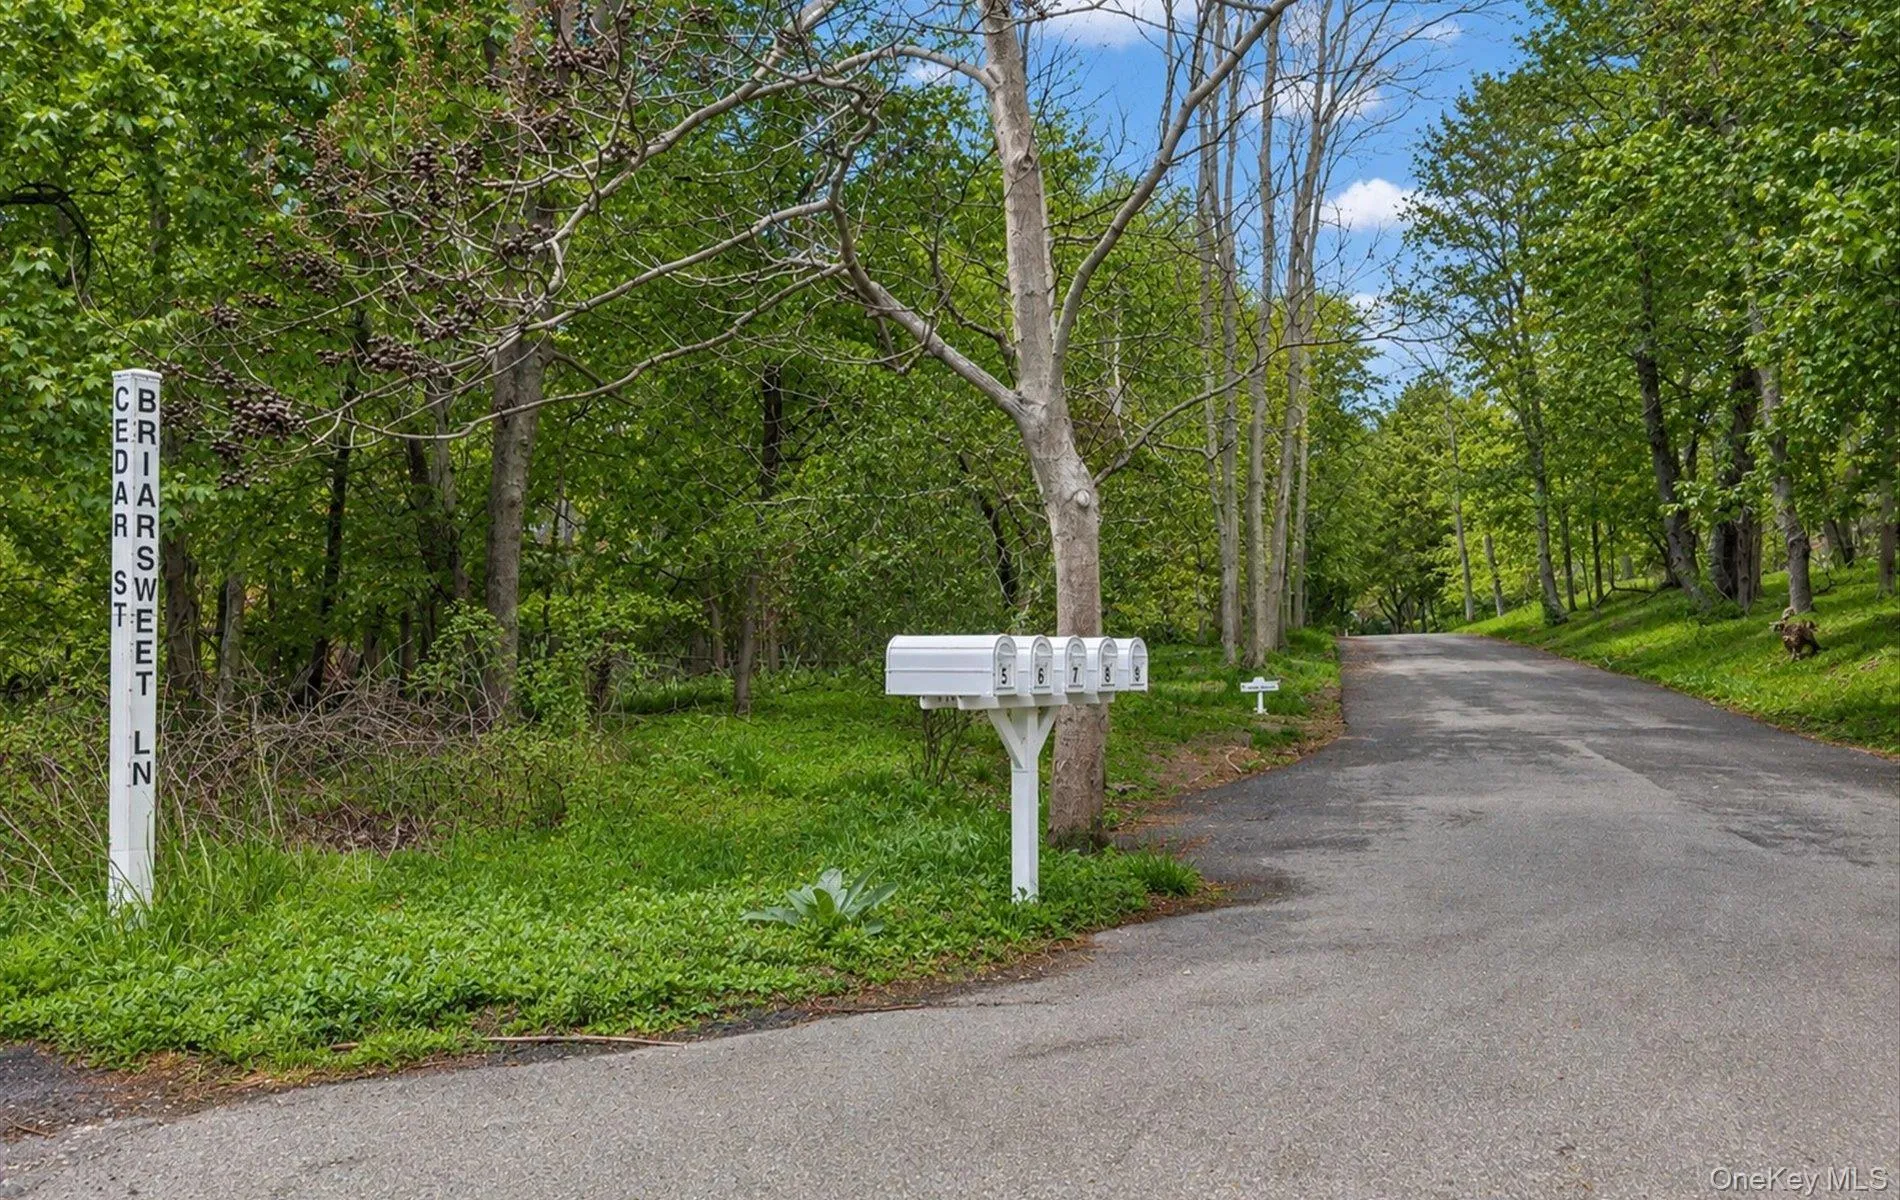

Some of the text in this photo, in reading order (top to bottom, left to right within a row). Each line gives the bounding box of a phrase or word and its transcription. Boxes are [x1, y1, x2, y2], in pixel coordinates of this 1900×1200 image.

[113, 386, 129, 628] CEDAR ST
[132, 388, 157, 786] BRIARSWEET LN
[1001, 667, 1008, 685] 5
[1037, 667, 1045, 685] 6
[1072, 666, 1079, 684] 7
[1104, 665, 1111, 683] 8
[1134, 665, 1141, 682] 9
